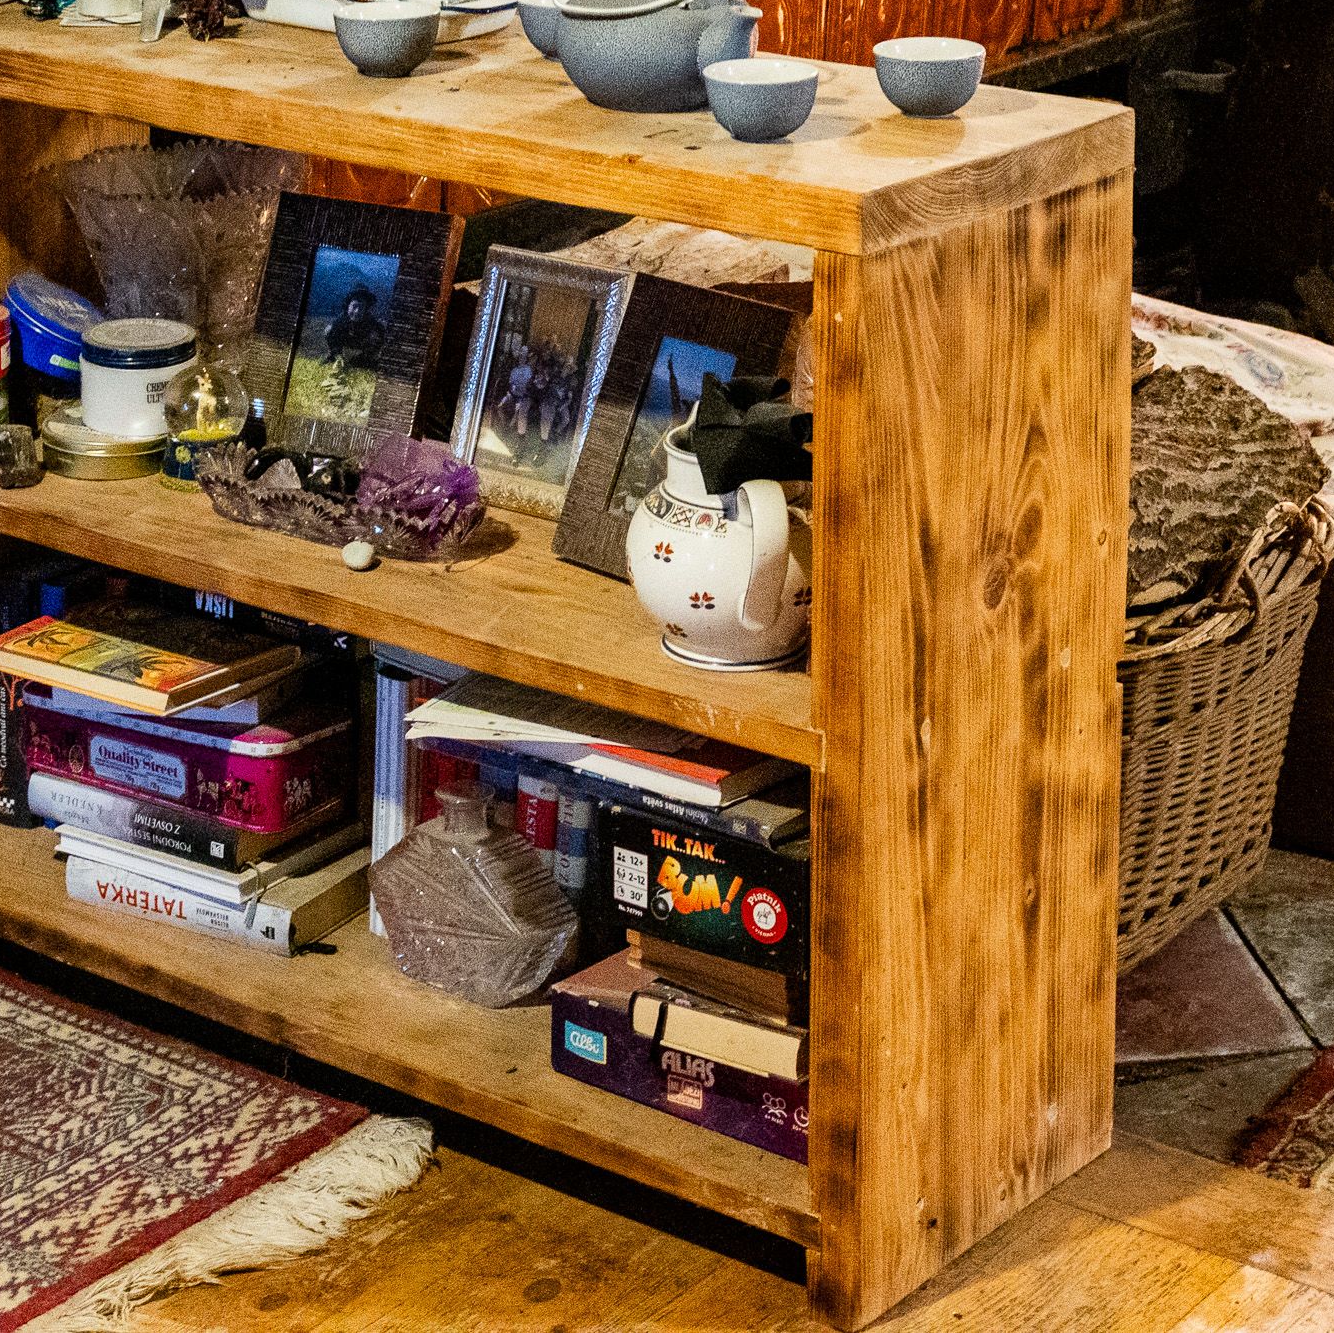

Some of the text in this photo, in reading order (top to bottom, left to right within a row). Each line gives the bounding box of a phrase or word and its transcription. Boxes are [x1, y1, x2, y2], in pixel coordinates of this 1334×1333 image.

[145, 379, 169, 392] CREM
[146, 392, 165, 404] ULT
[98, 744, 179, 779] Quality Street
[49, 790, 102, 815] KNEDLER
[662, 801, 684, 816] Atlas
[172, 823, 181, 834] Z
[629, 855, 643, 866] 12+
[628, 872, 645, 885] 2-12
[656, 854, 743, 916] BUM!
[96, 878, 187, 921] TATÉRKA
[746, 892, 782, 913] Piatnik
